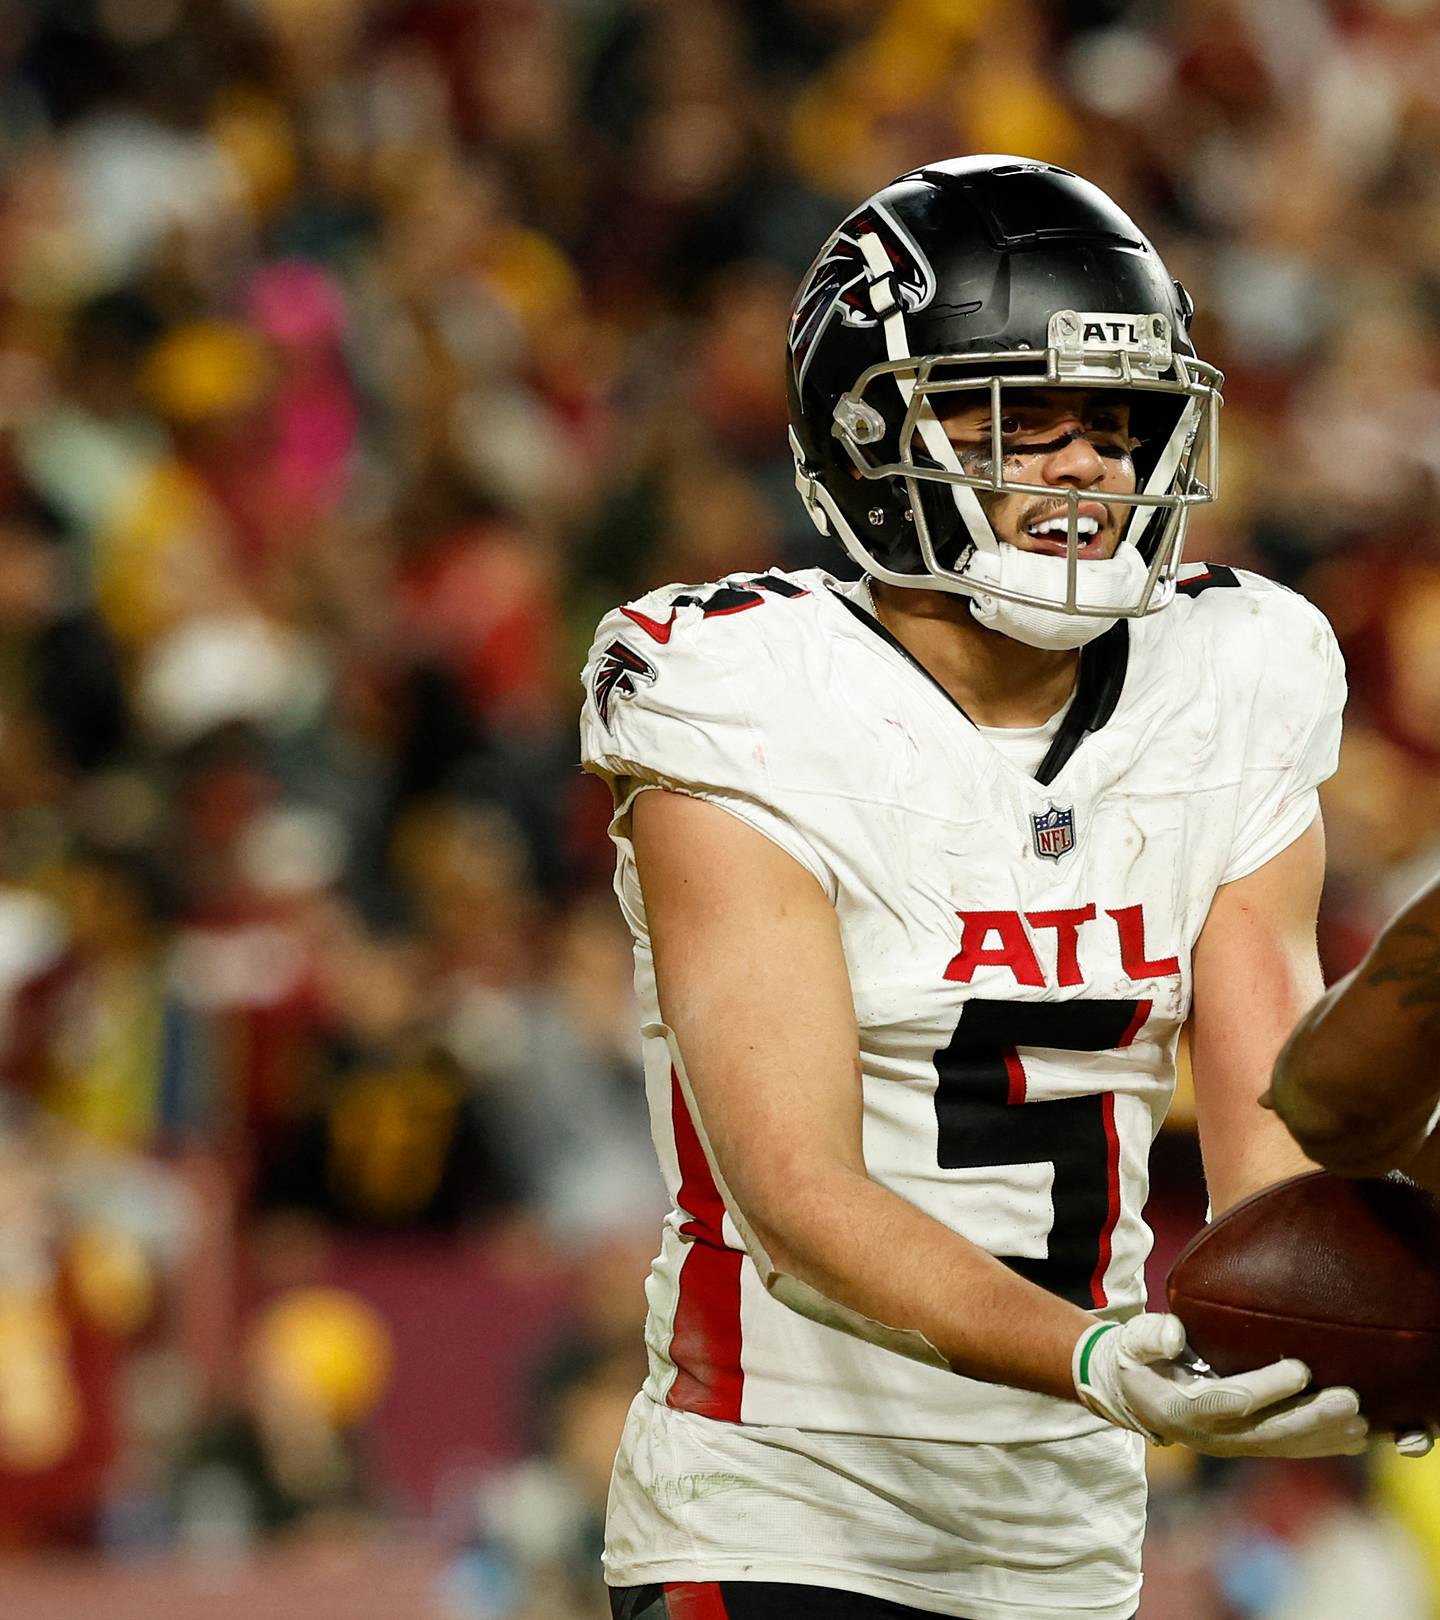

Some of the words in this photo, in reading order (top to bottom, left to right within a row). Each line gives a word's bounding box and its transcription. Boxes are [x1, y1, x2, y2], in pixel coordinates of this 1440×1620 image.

[1083, 322, 1139, 343] ATL
[1040, 827, 1071, 853] NFL
[942, 902, 1181, 988] ATL
[932, 997, 1154, 1311] 5
